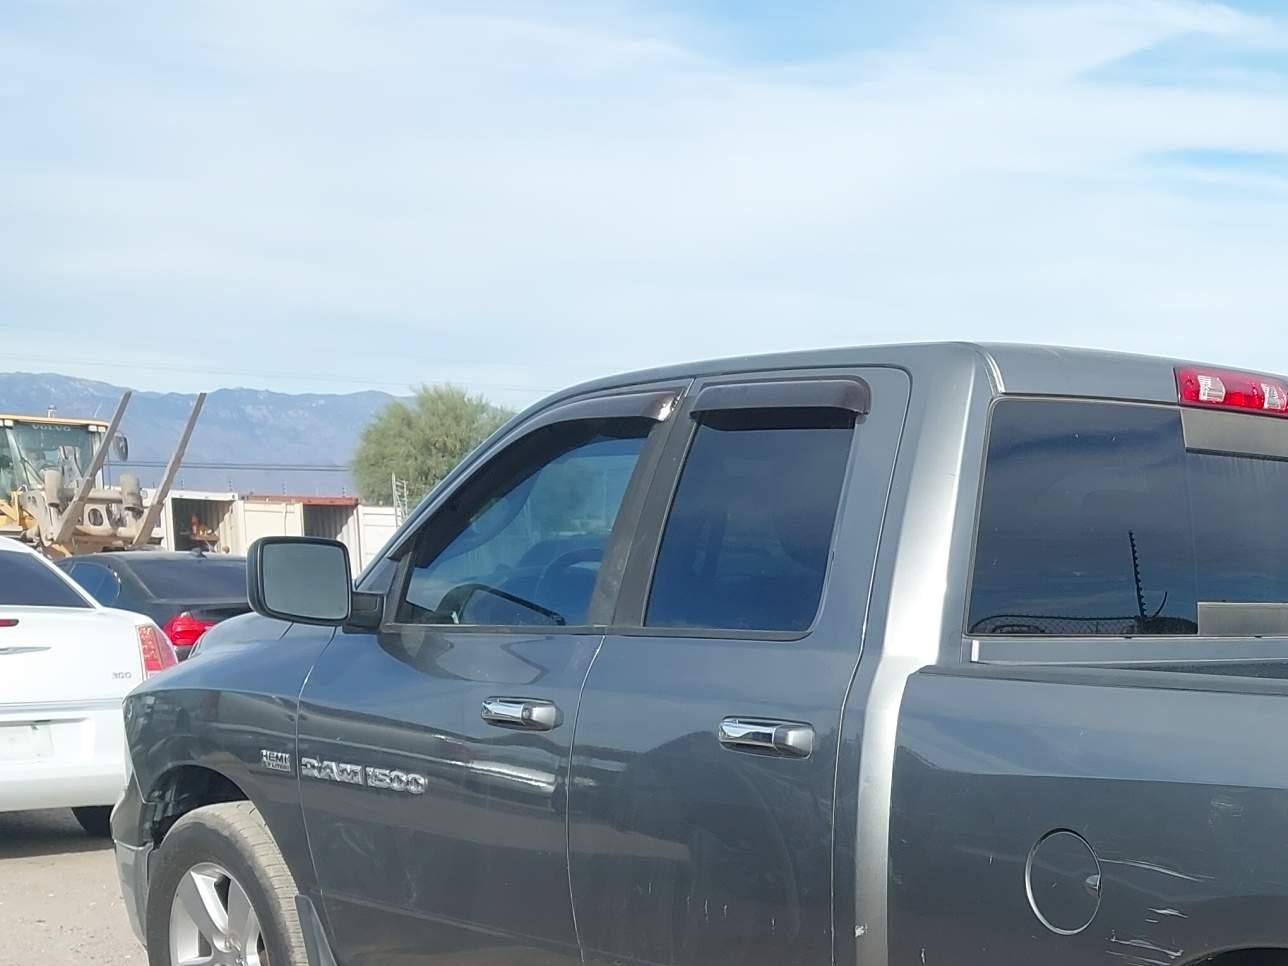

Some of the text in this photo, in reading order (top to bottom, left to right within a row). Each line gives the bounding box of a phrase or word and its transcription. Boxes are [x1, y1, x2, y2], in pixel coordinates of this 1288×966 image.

[31, 423, 71, 432] VOLVO
[260, 750, 290, 764] HEMI
[301, 757, 428, 795] RAM 1500
